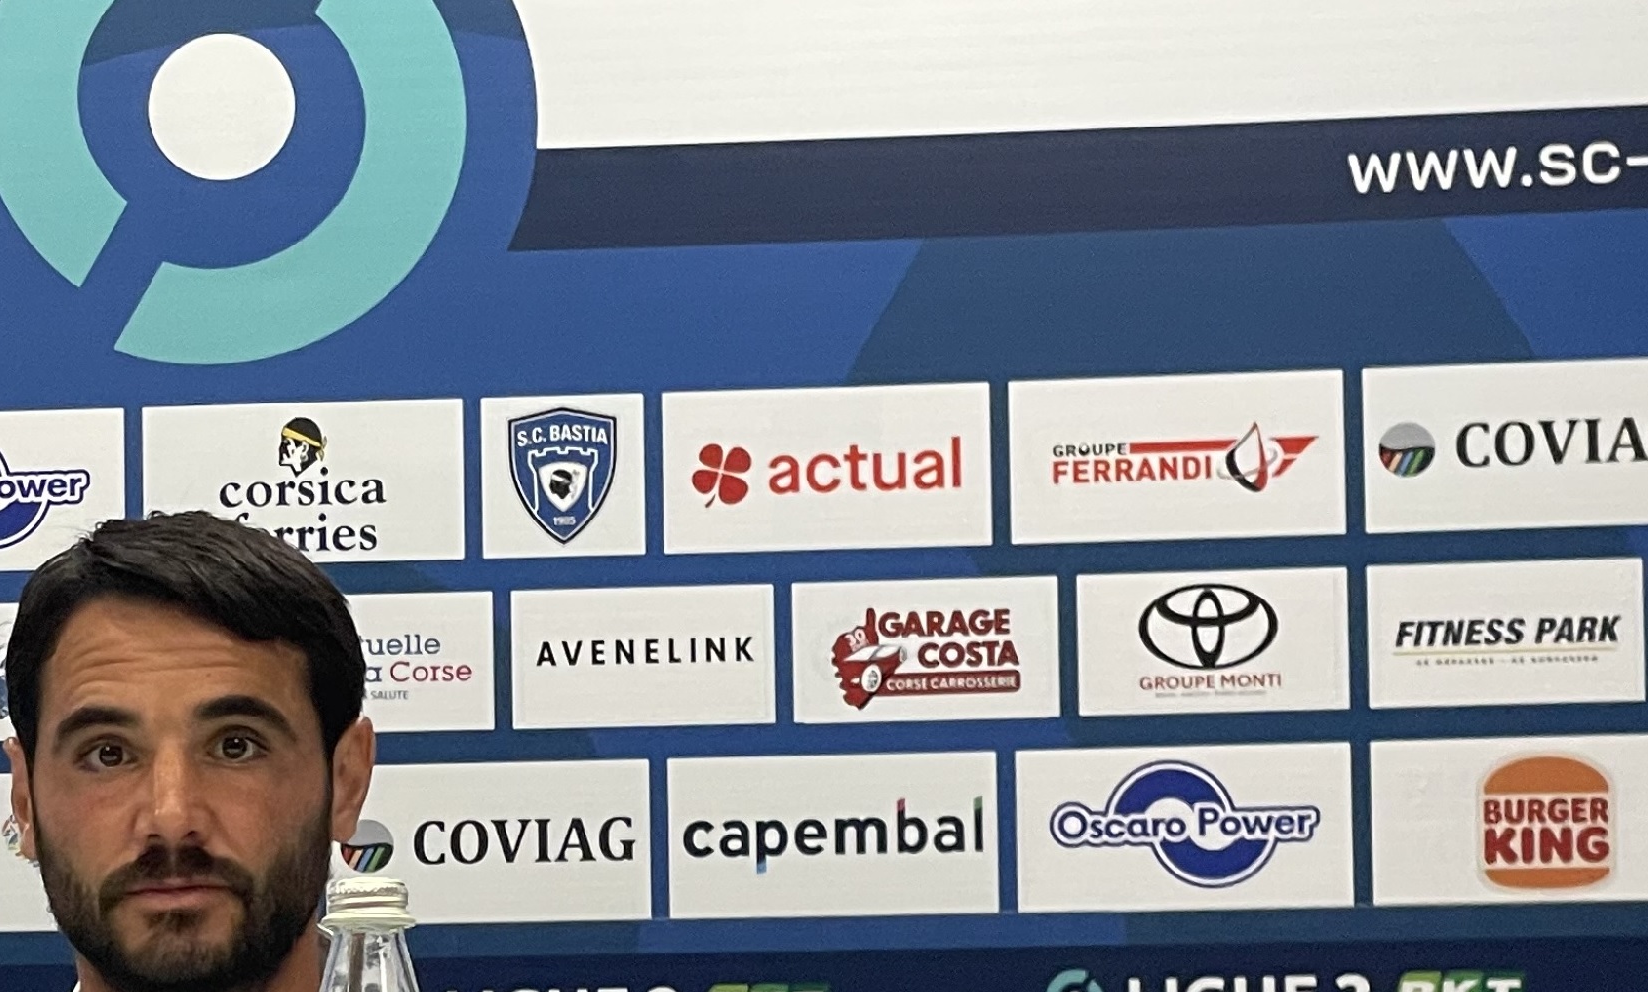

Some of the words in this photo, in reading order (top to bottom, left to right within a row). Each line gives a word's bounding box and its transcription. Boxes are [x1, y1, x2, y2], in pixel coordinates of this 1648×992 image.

[517, 426, 547, 447] S.C.
[550, 424, 608, 445] BASTIA
[1053, 443, 1127, 457] GROUPE
[768, 436, 961, 495] actual
[1052, 456, 1212, 485] FERRANDI
[219, 467, 386, 508] corsica
[878, 609, 1010, 638] GARAGE
[1396, 618, 1526, 647] FITNESS
[1535, 615, 1621, 643] PARK
[537, 636, 754, 668] AVENELINK
[918, 640, 1019, 668] COSTA
[390, 661, 472, 682] Corse
[886, 677, 927, 690] CORSE
[930, 676, 1017, 688] CARROSSERIE
[1139, 674, 1216, 690] GROUPE
[1221, 673, 1282, 687] MONTI
[1058, 812, 1186, 839] Oscaro
[1198, 808, 1313, 837] Power
[1484, 797, 1608, 825] BURGER
[413, 817, 635, 865] COVIAG
[682, 797, 983, 875] capembal
[1484, 827, 1610, 866] KING
